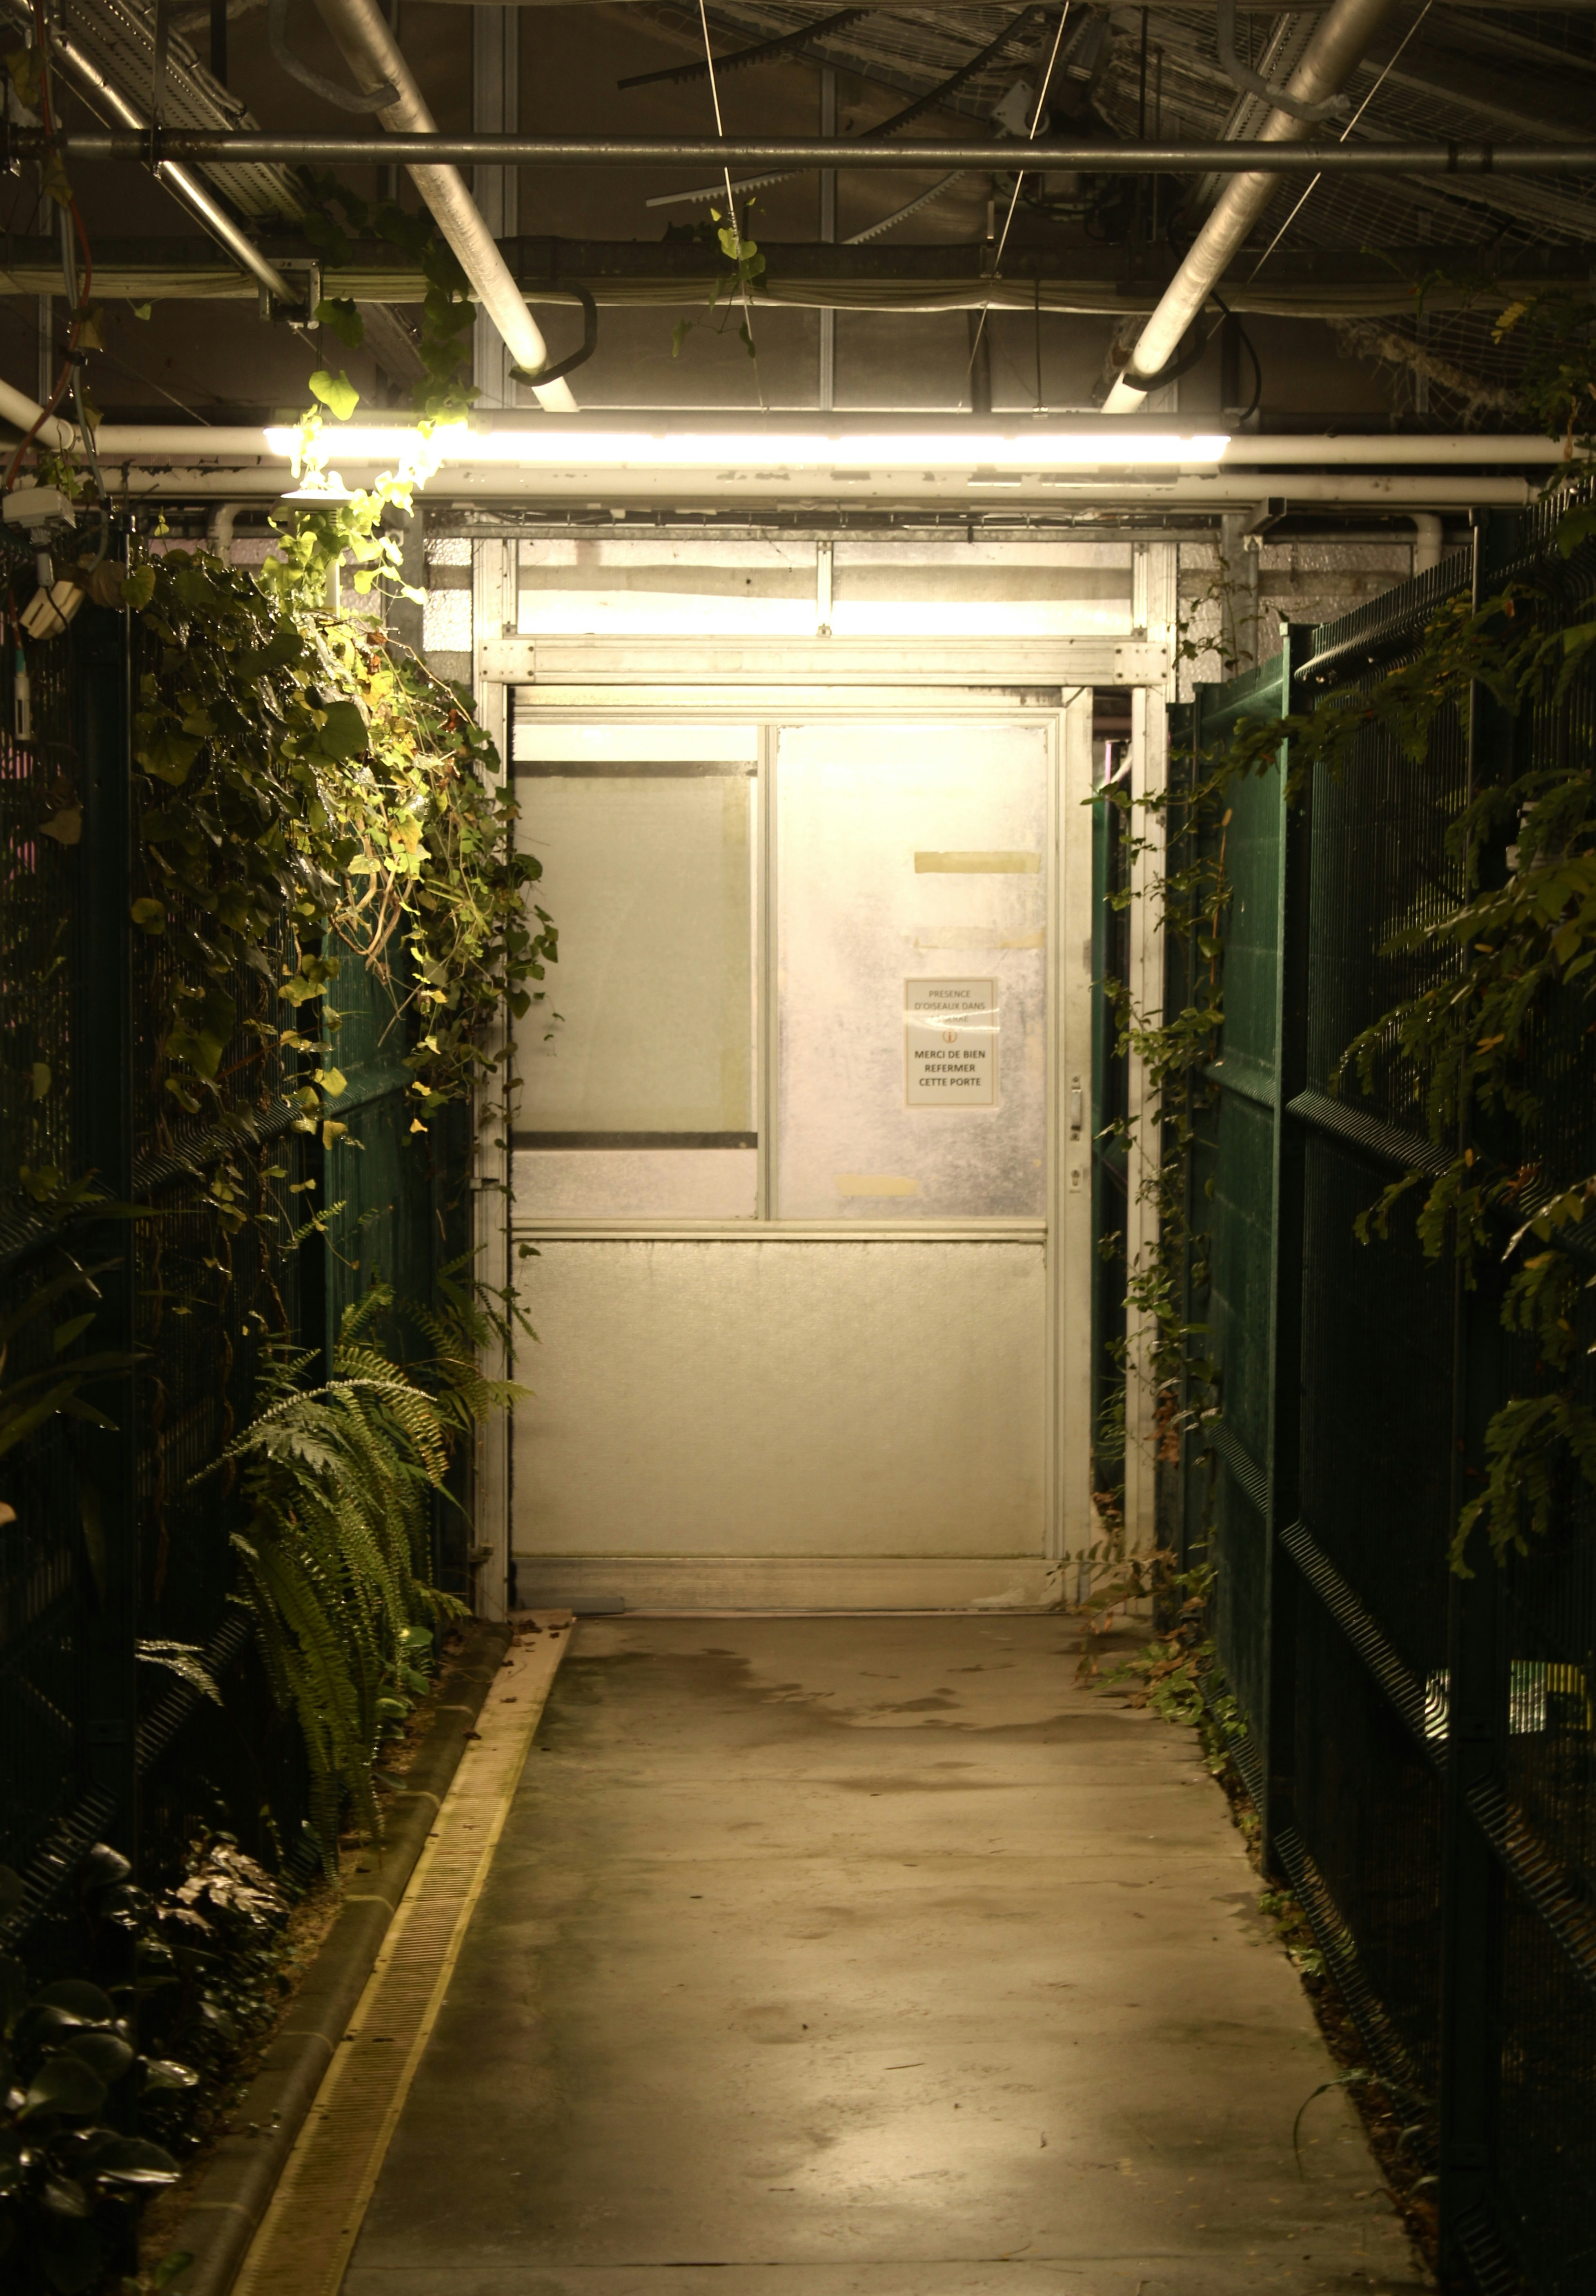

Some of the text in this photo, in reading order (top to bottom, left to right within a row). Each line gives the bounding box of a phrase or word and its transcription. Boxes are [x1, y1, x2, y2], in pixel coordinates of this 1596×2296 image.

[929, 990, 971, 998] PRESENCE
[962, 1002, 986, 1010] DANS
[915, 1050, 986, 1059] MERCI DE BIEN
[925, 1064, 975, 1072] REFERMER
[919, 1077, 981, 1086] CETTE PORTE
